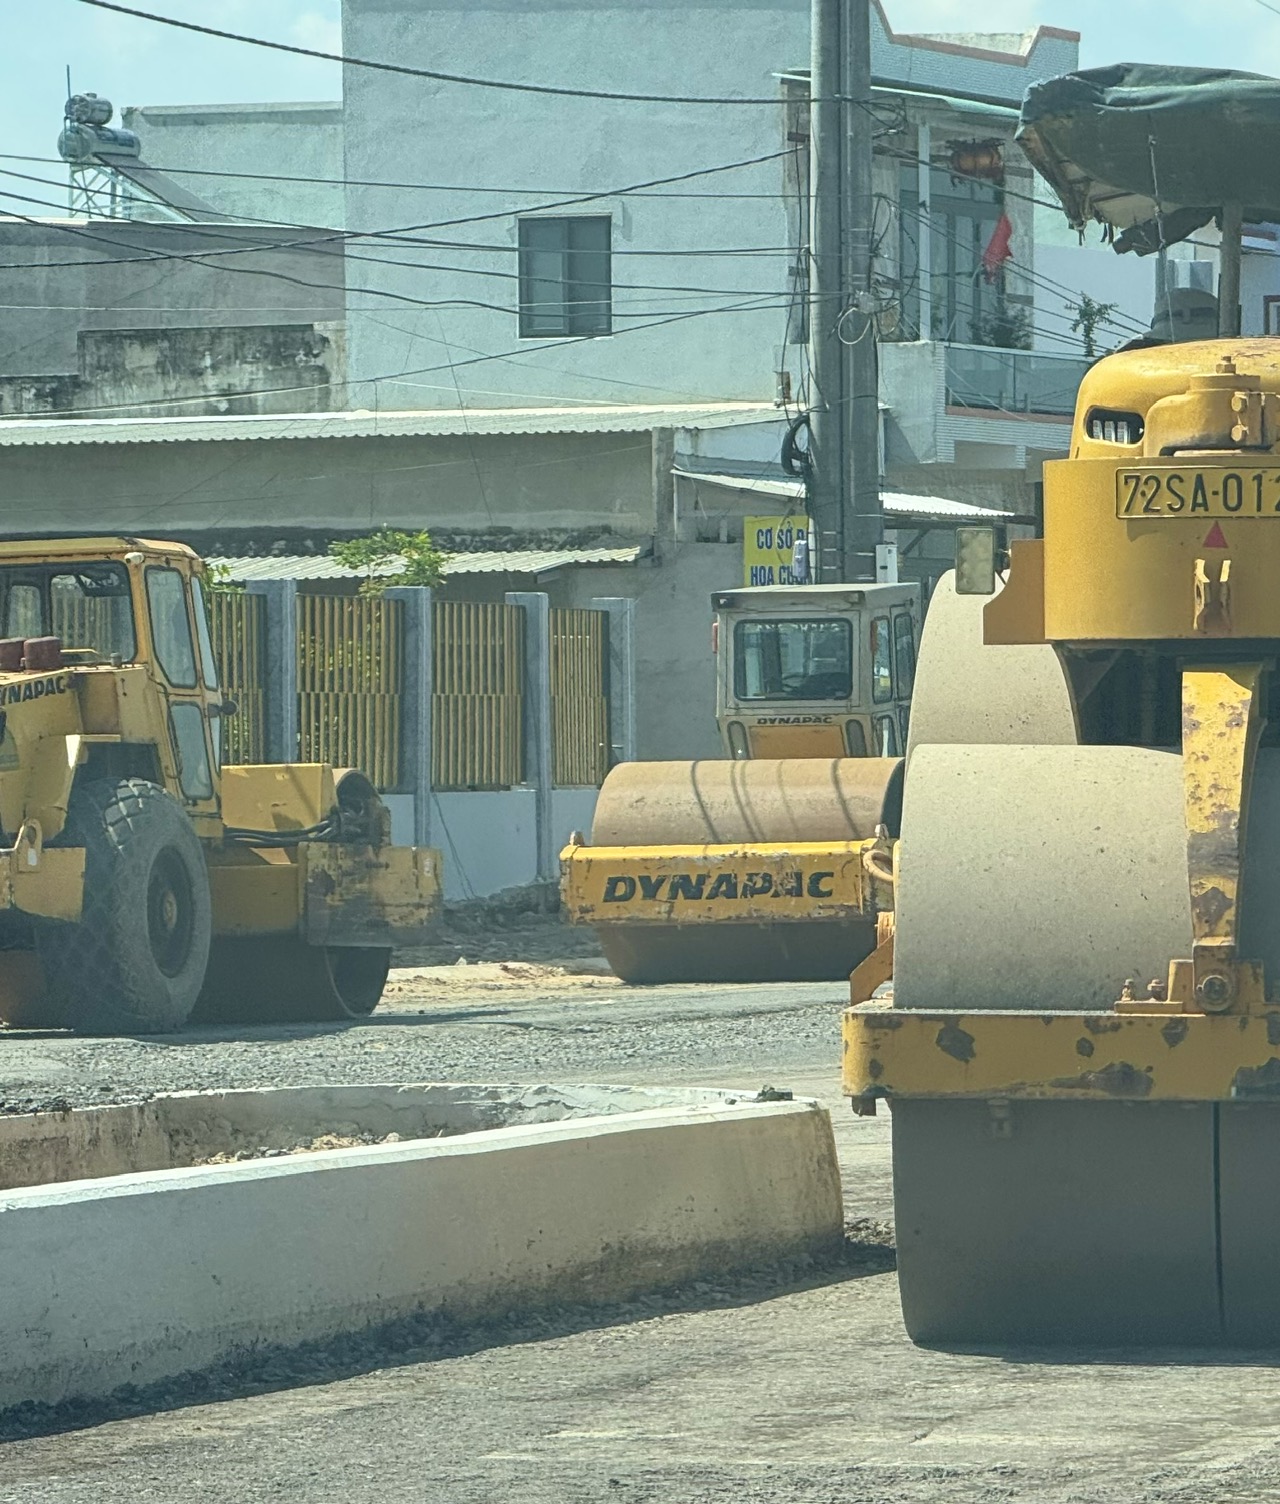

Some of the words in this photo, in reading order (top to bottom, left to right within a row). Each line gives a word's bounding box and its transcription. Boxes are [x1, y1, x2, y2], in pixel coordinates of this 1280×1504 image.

[756, 527, 773, 550] CƠ
[776, 520, 793, 550] SỞ
[750, 565, 774, 586] HOA
[757, 716, 833, 725] DYNAPAC
[602, 871, 835, 903] DYNAPAC
